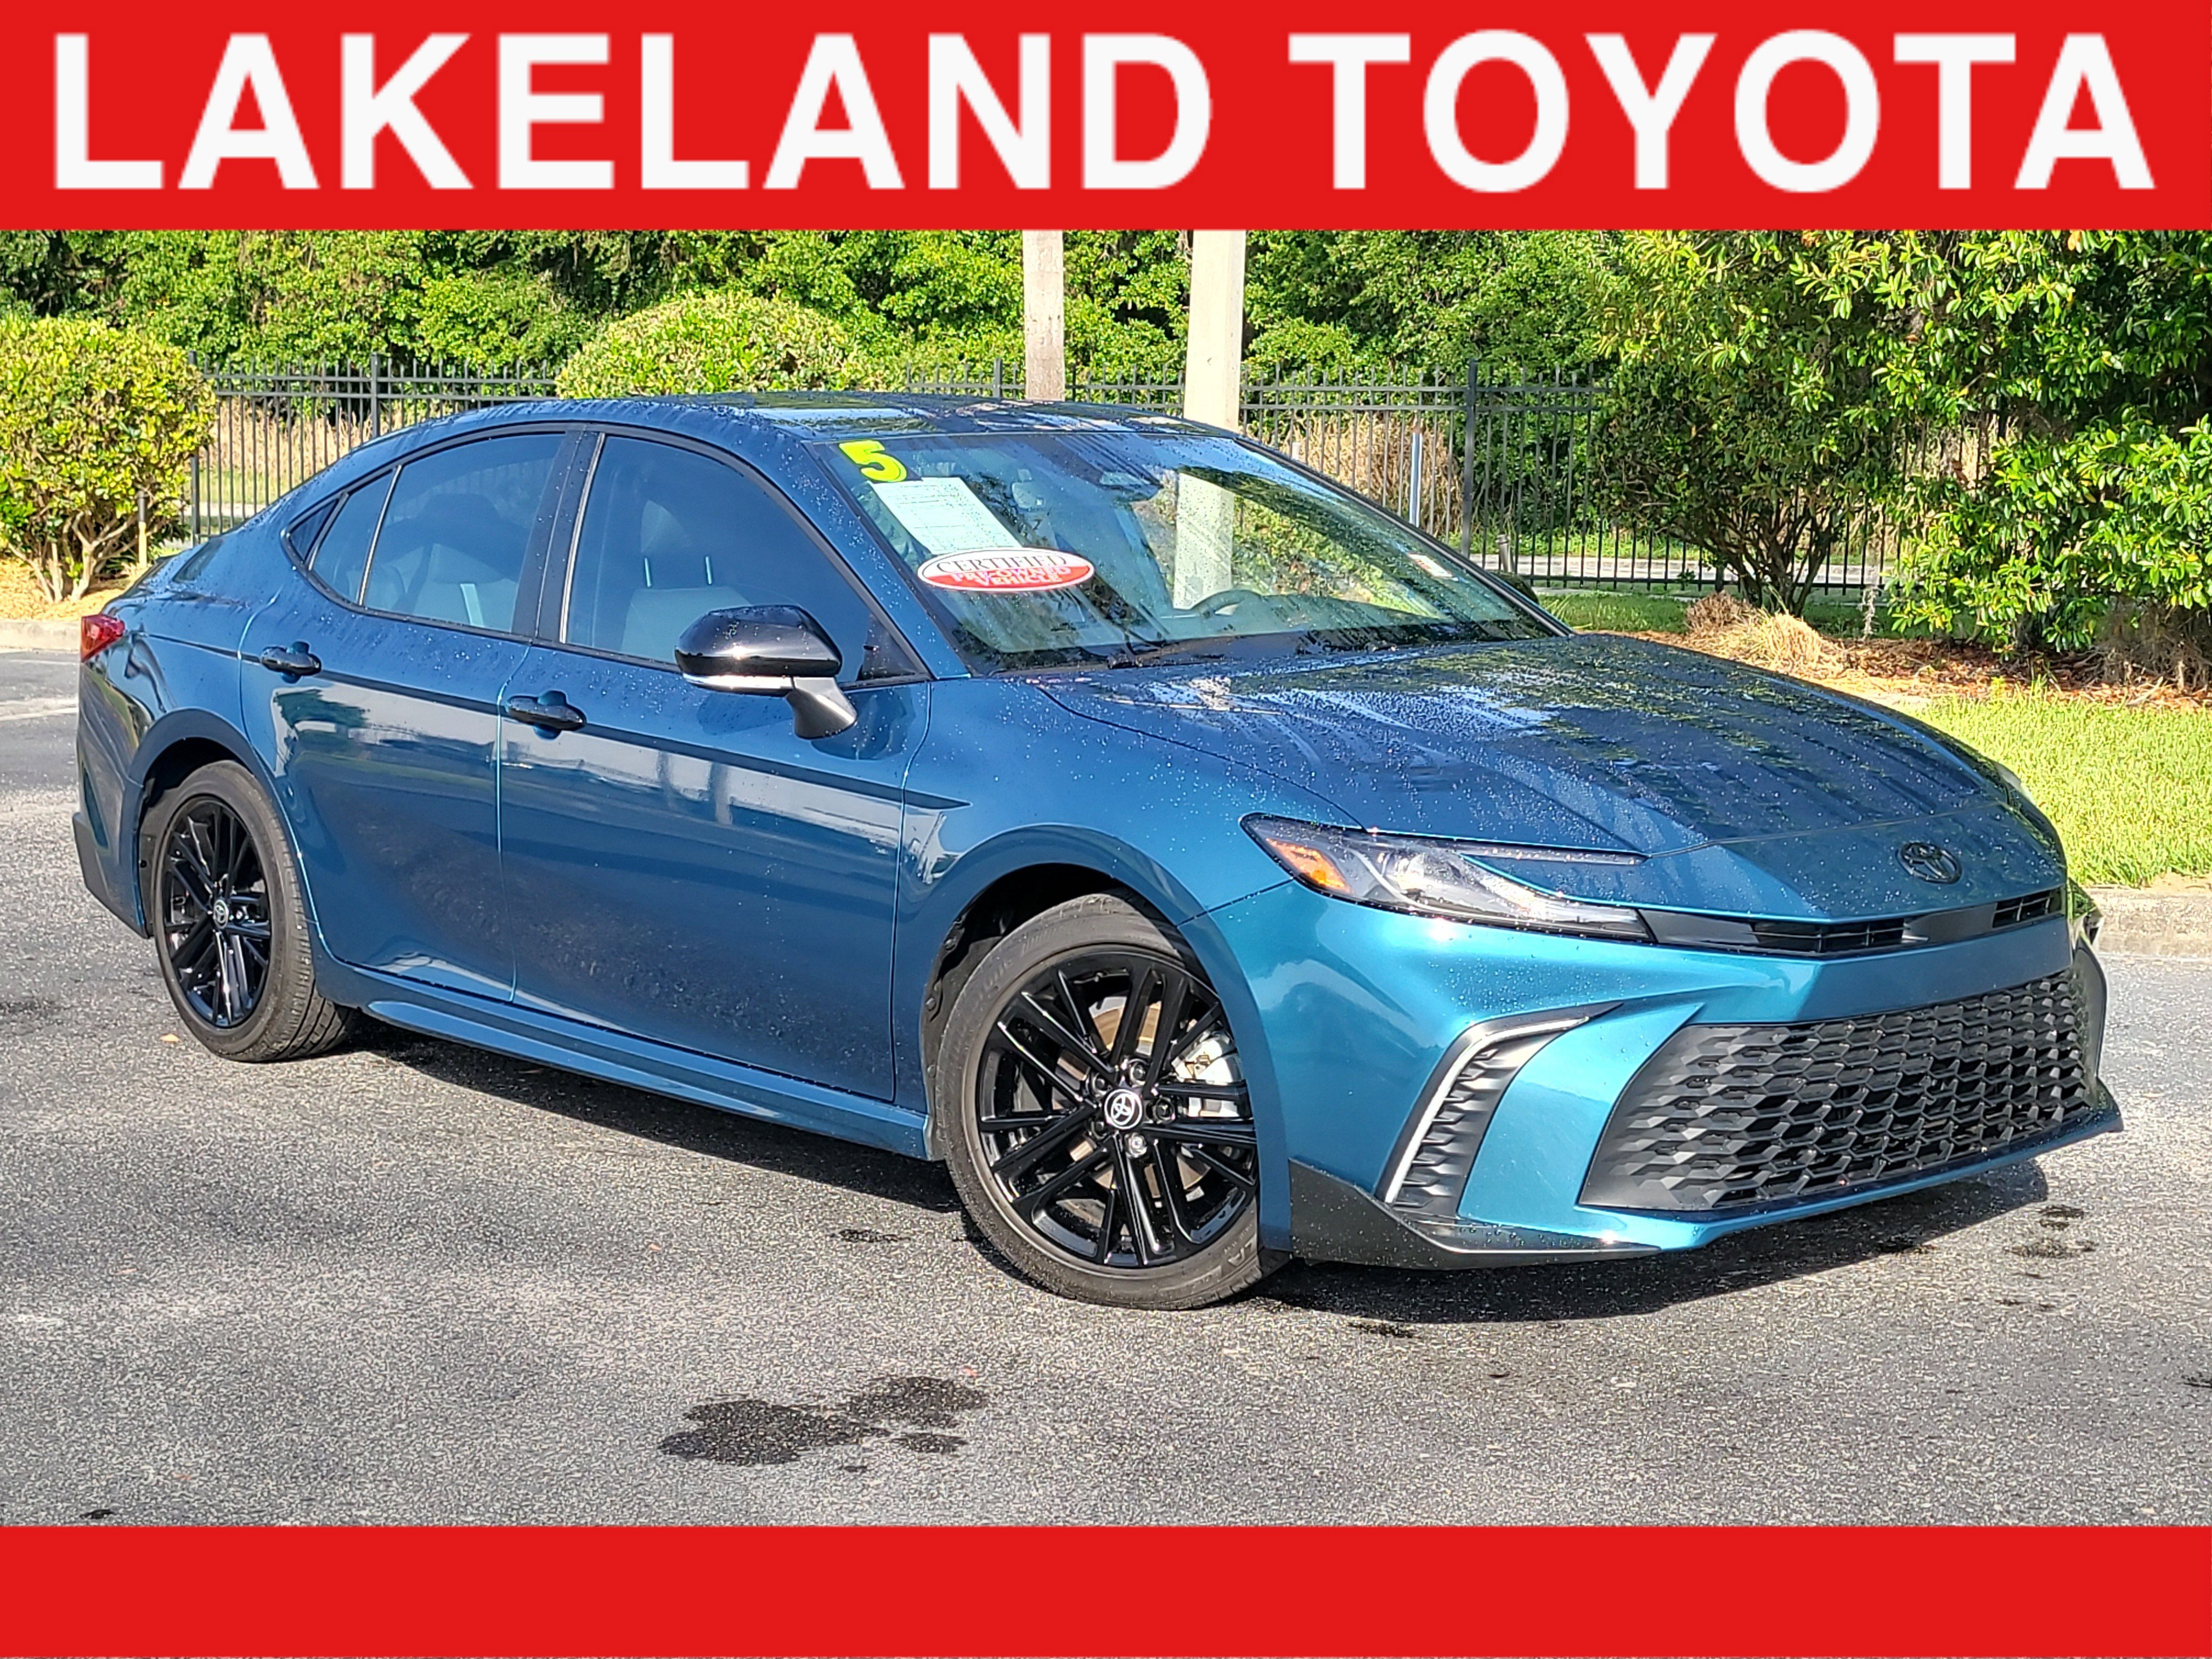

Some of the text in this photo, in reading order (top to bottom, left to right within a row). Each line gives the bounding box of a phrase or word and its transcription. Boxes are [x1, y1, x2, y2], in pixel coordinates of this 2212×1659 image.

[839, 440, 906, 482] 5
[936, 555, 1067, 573] CERTIFIED
[974, 572, 1063, 586] VEHICLE
